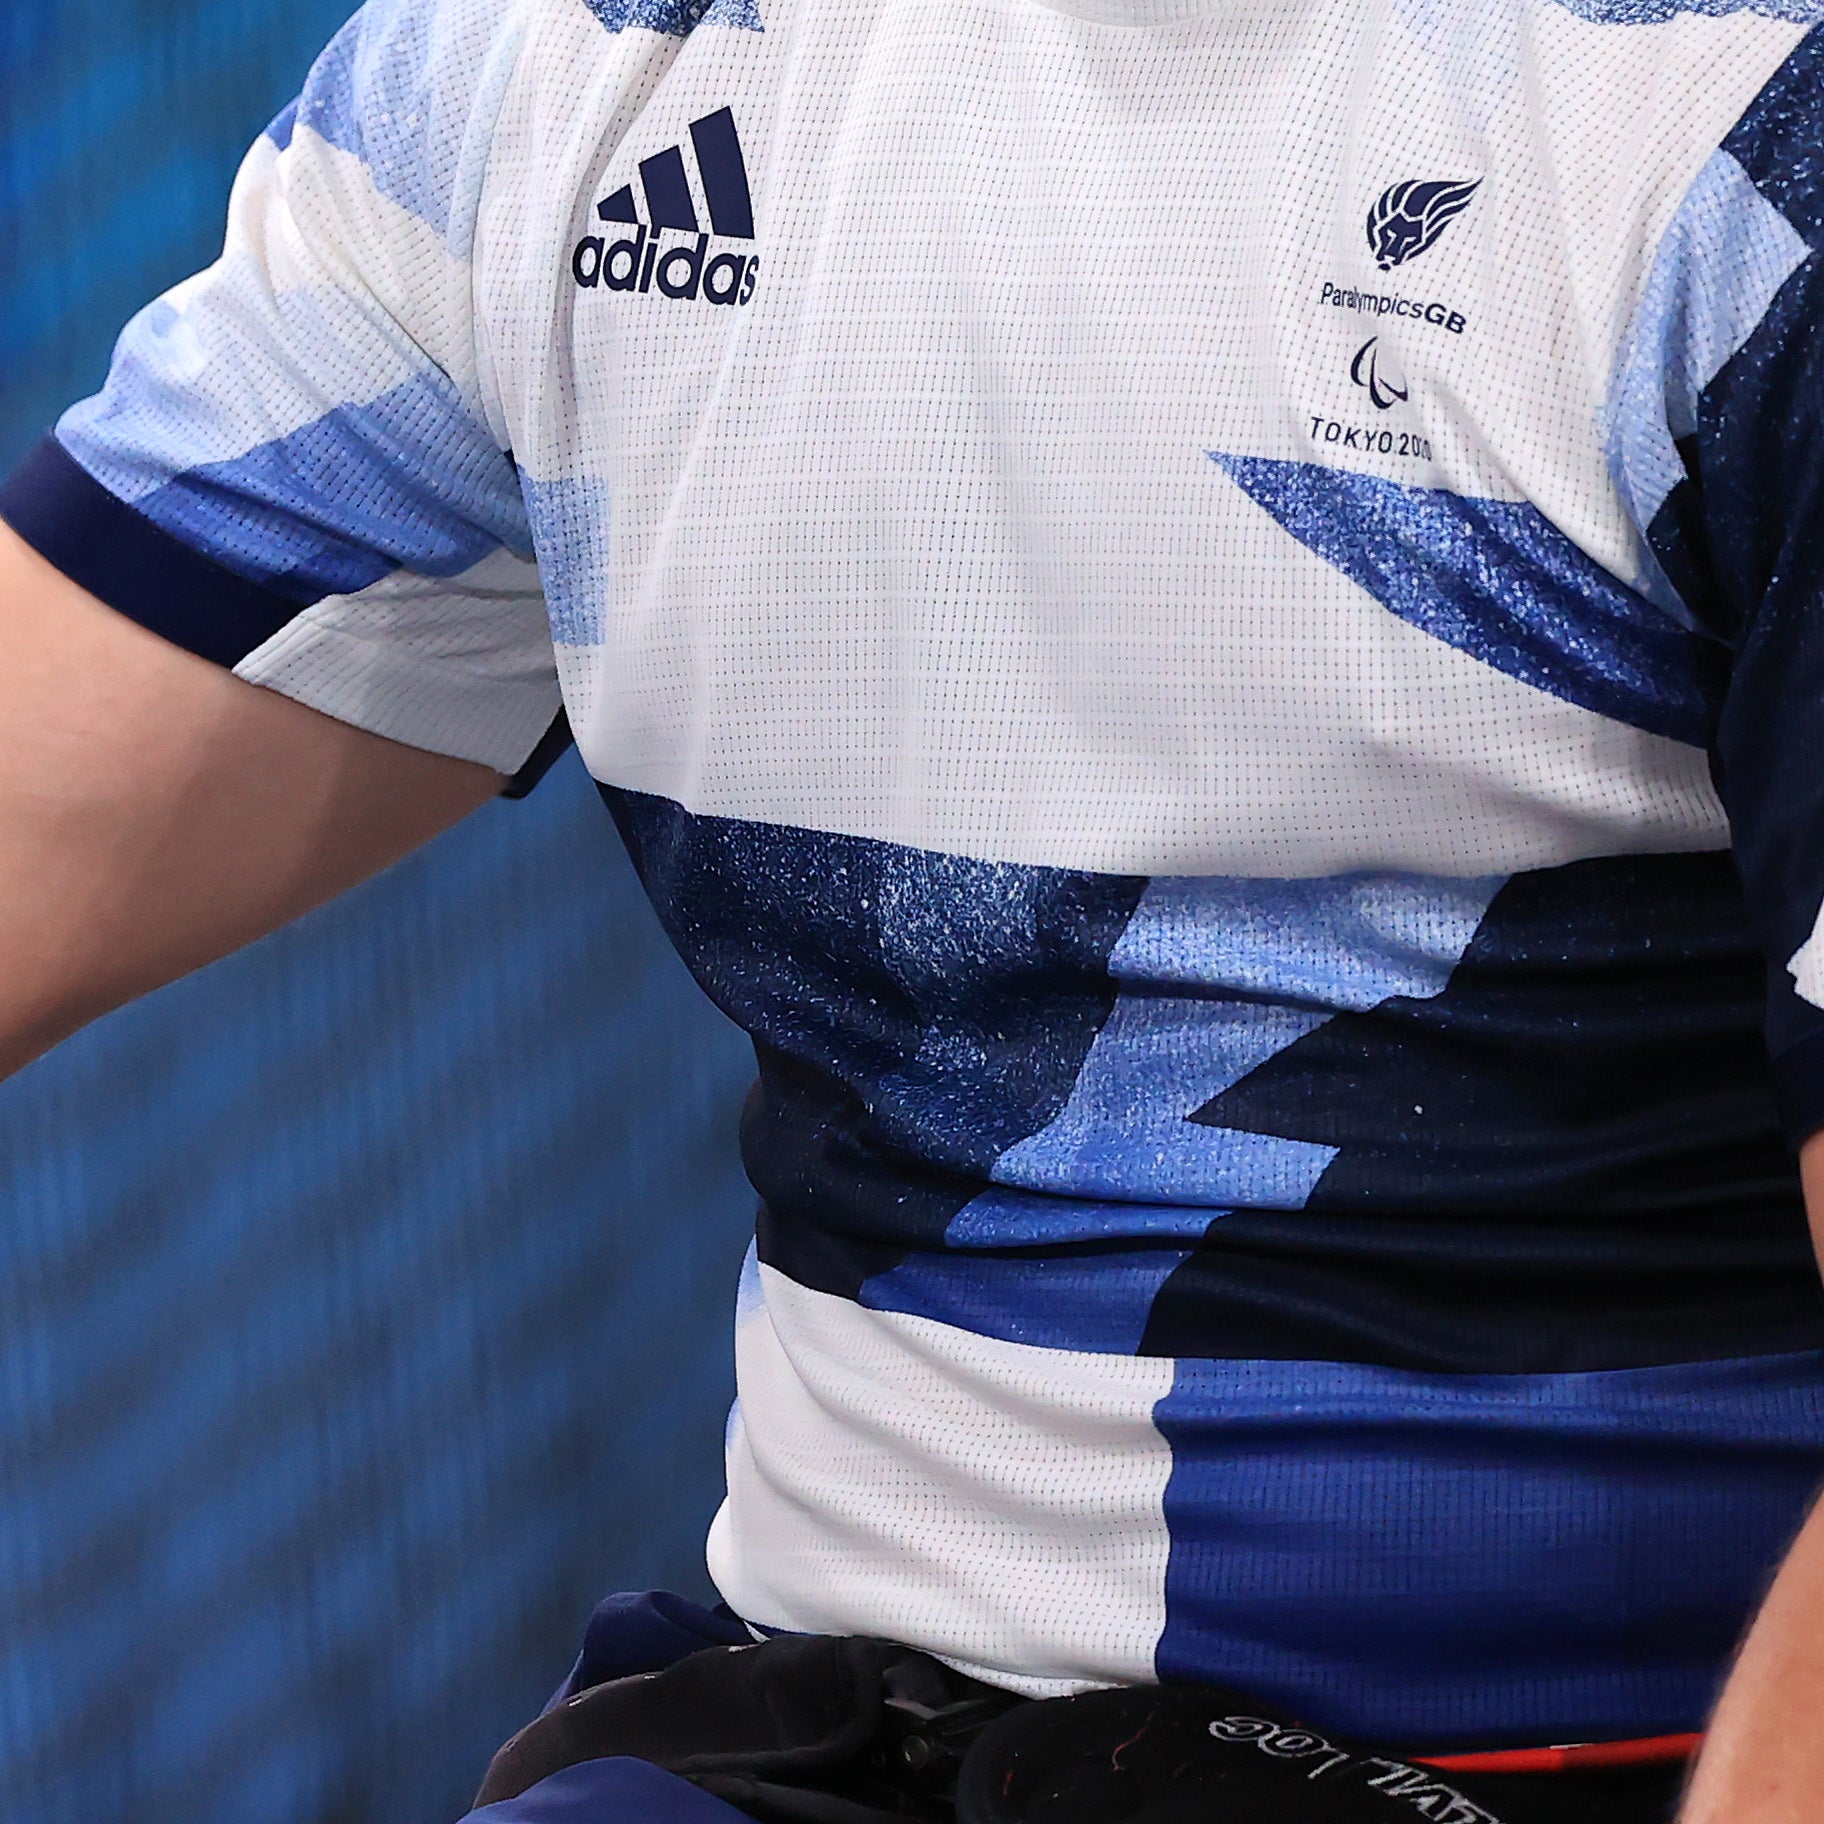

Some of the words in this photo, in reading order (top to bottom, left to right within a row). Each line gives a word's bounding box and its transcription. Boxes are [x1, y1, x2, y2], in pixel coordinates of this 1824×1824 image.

[571, 222, 760, 307] adidas
[1319, 281, 1468, 335] ParalympicsGB
[1309, 415, 1393, 454] TOKYO
